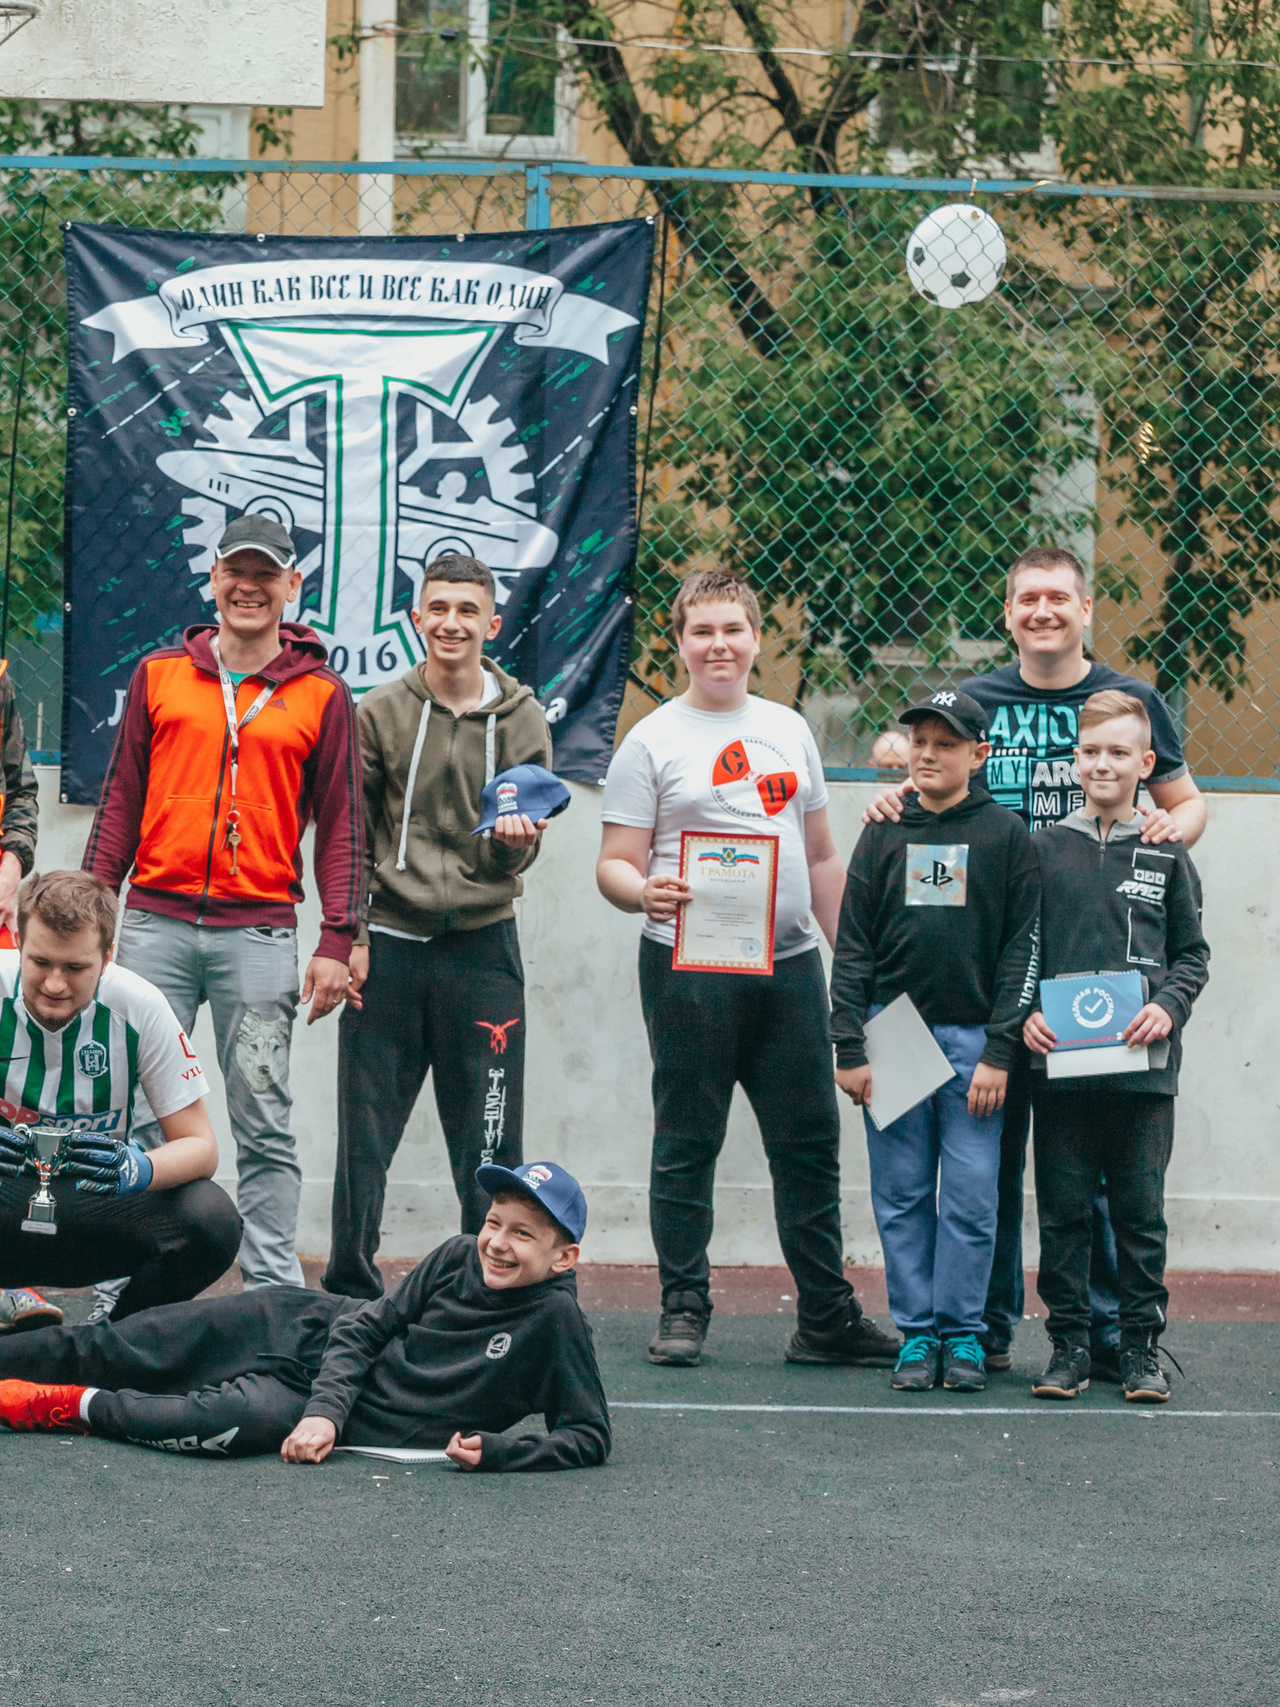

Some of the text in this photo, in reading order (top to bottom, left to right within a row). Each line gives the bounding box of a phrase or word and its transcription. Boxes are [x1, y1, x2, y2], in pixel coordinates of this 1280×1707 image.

[180, 274, 554, 312] ОДИН КАК ВСЕ И ВСЕ КАК ОДИН
[328, 641, 397, 676] 016
[988, 704, 1084, 748] AXIO
[991, 759, 1021, 786] MY
[701, 867, 756, 879] ГРАМОТА
[1072, 987, 1114, 1018] ЕДИНАЯ РОССИЯ
[77, 1133, 111, 1143] DEMIX
